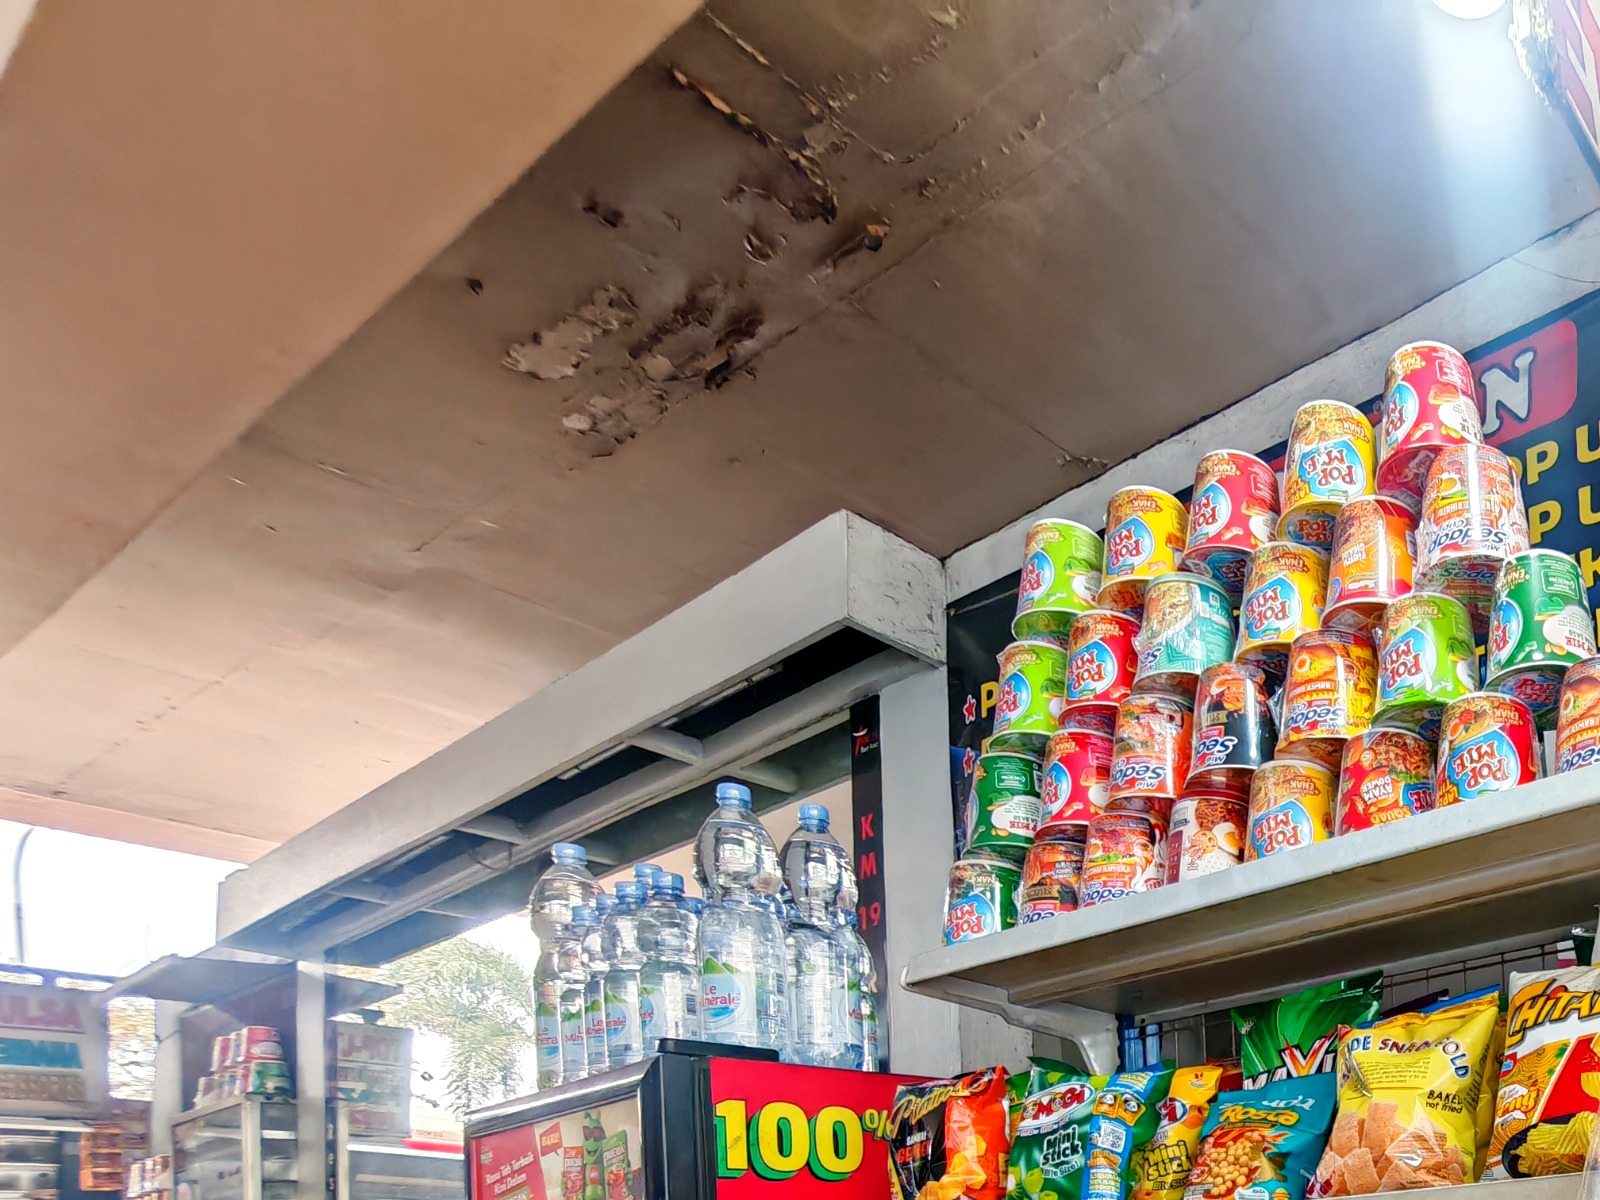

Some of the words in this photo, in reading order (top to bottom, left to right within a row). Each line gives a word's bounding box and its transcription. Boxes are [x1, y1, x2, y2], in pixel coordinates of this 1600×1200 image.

[1316, 464, 1358, 488] POP
[1452, 740, 1499, 778] MIE
[1465, 756, 1509, 791] POP
[1263, 822, 1303, 856] POP
[1425, 1101, 1443, 1114] not
[1427, 1089, 1463, 1105] BAKED
[1218, 1105, 1301, 1128] Rosta
[1046, 1125, 1078, 1152] Mini
[1148, 1140, 1191, 1168] Mini
